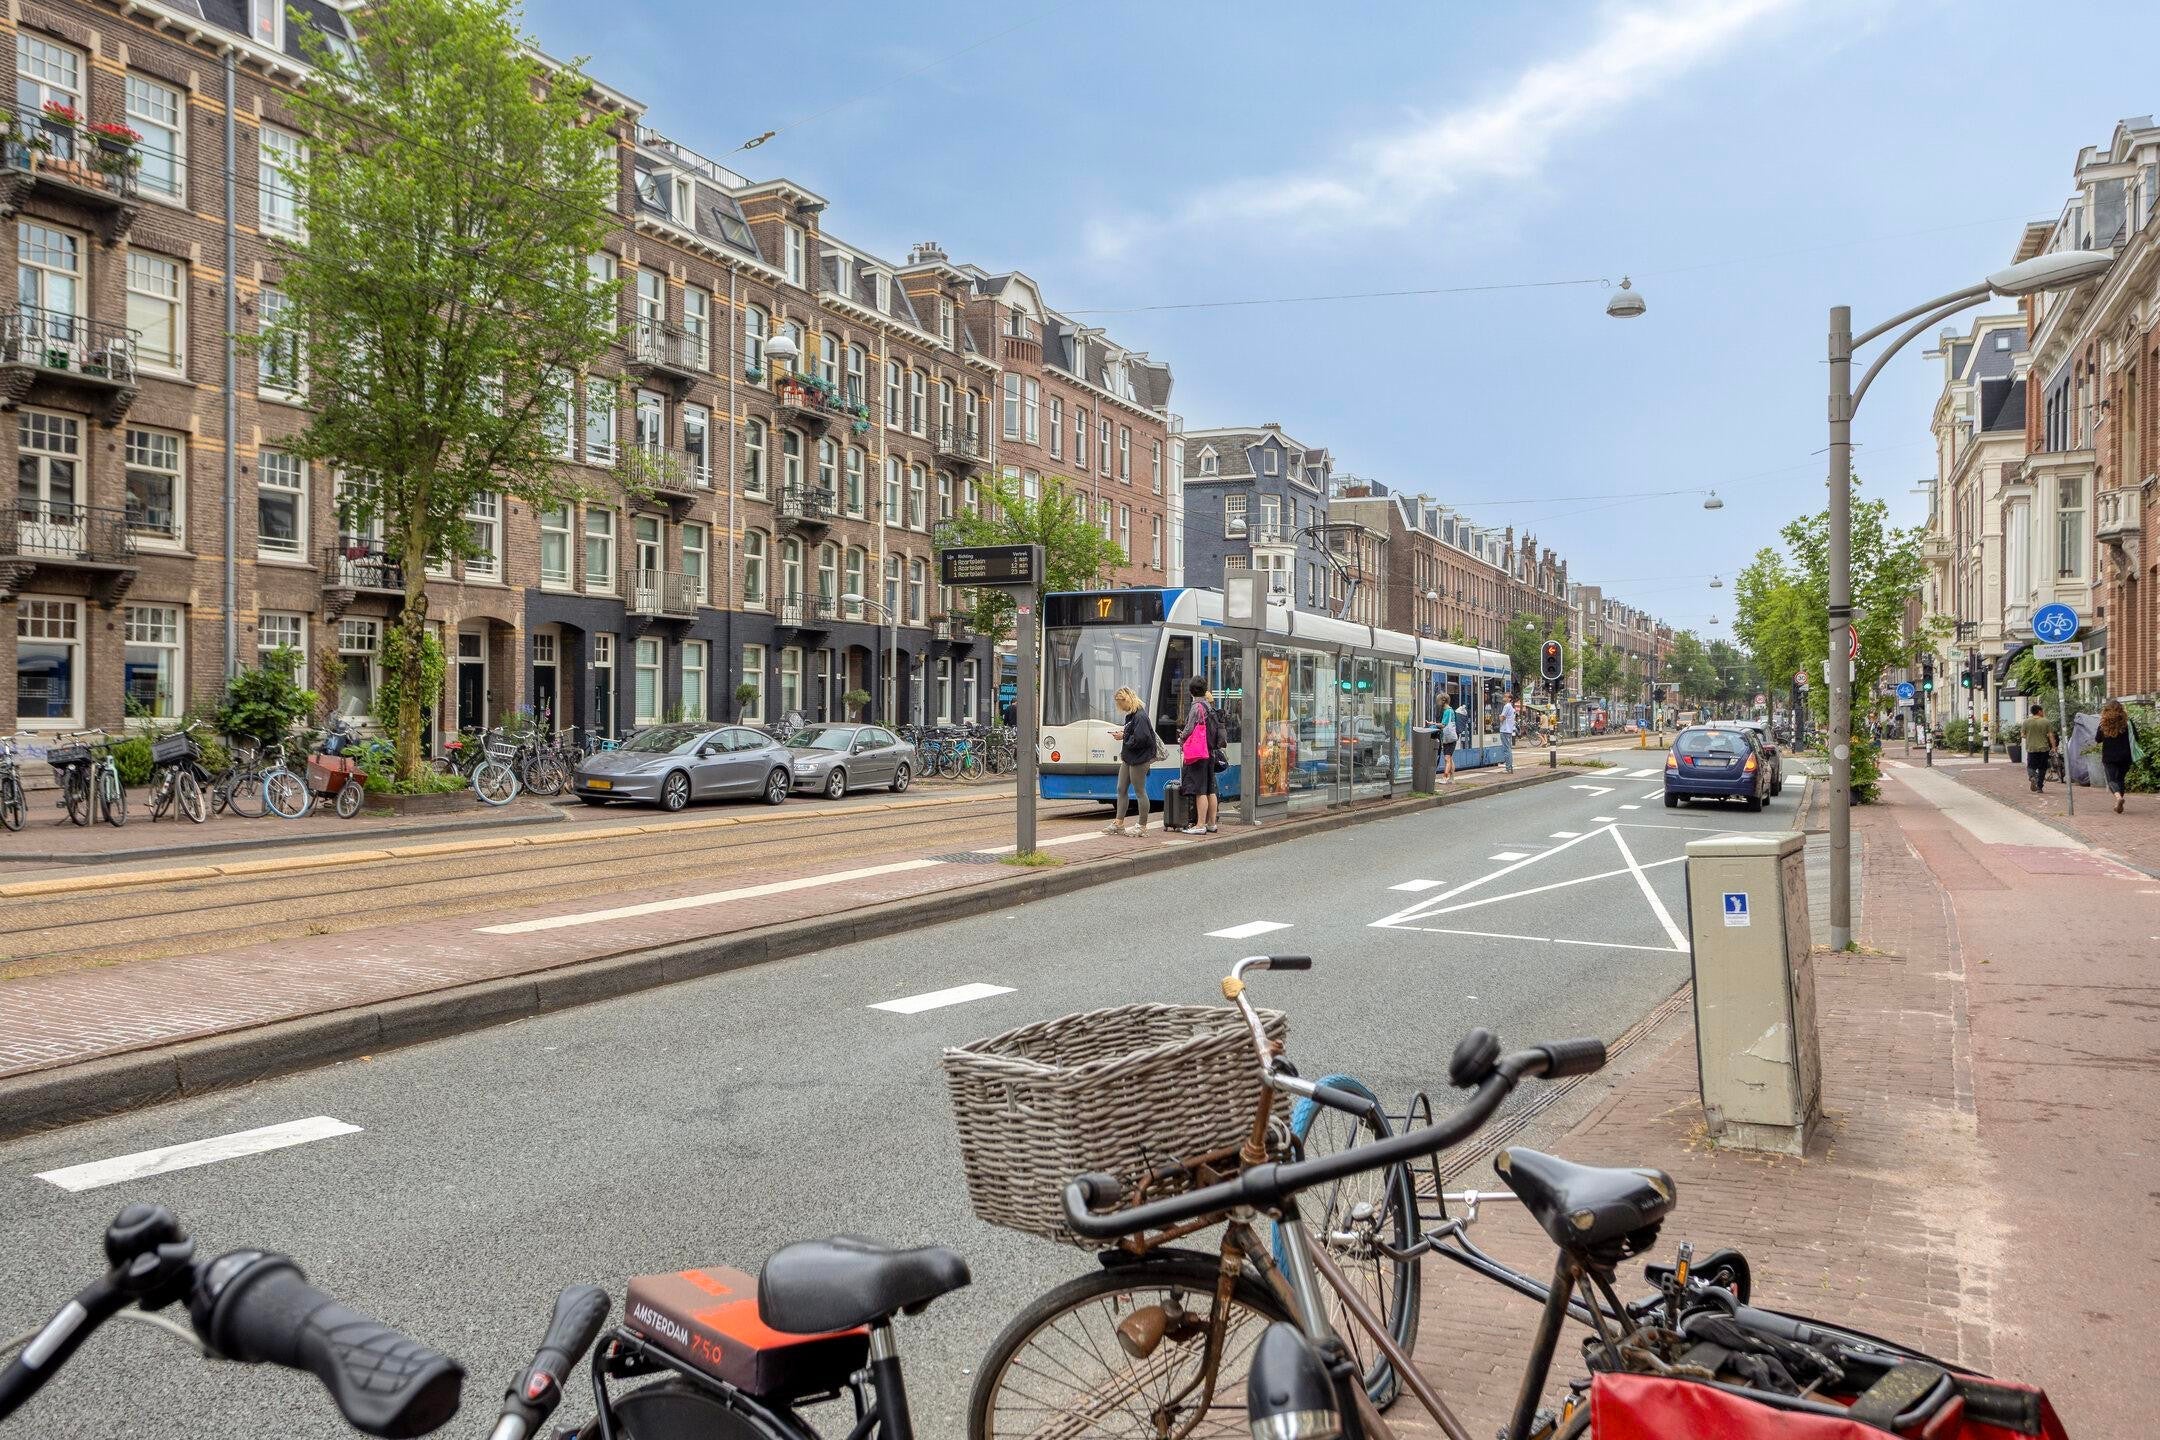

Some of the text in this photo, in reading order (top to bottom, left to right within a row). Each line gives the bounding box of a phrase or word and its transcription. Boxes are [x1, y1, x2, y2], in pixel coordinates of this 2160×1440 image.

[1097, 598, 1112, 618] 17
[633, 1302, 722, 1365] AMSTERDAM 750
